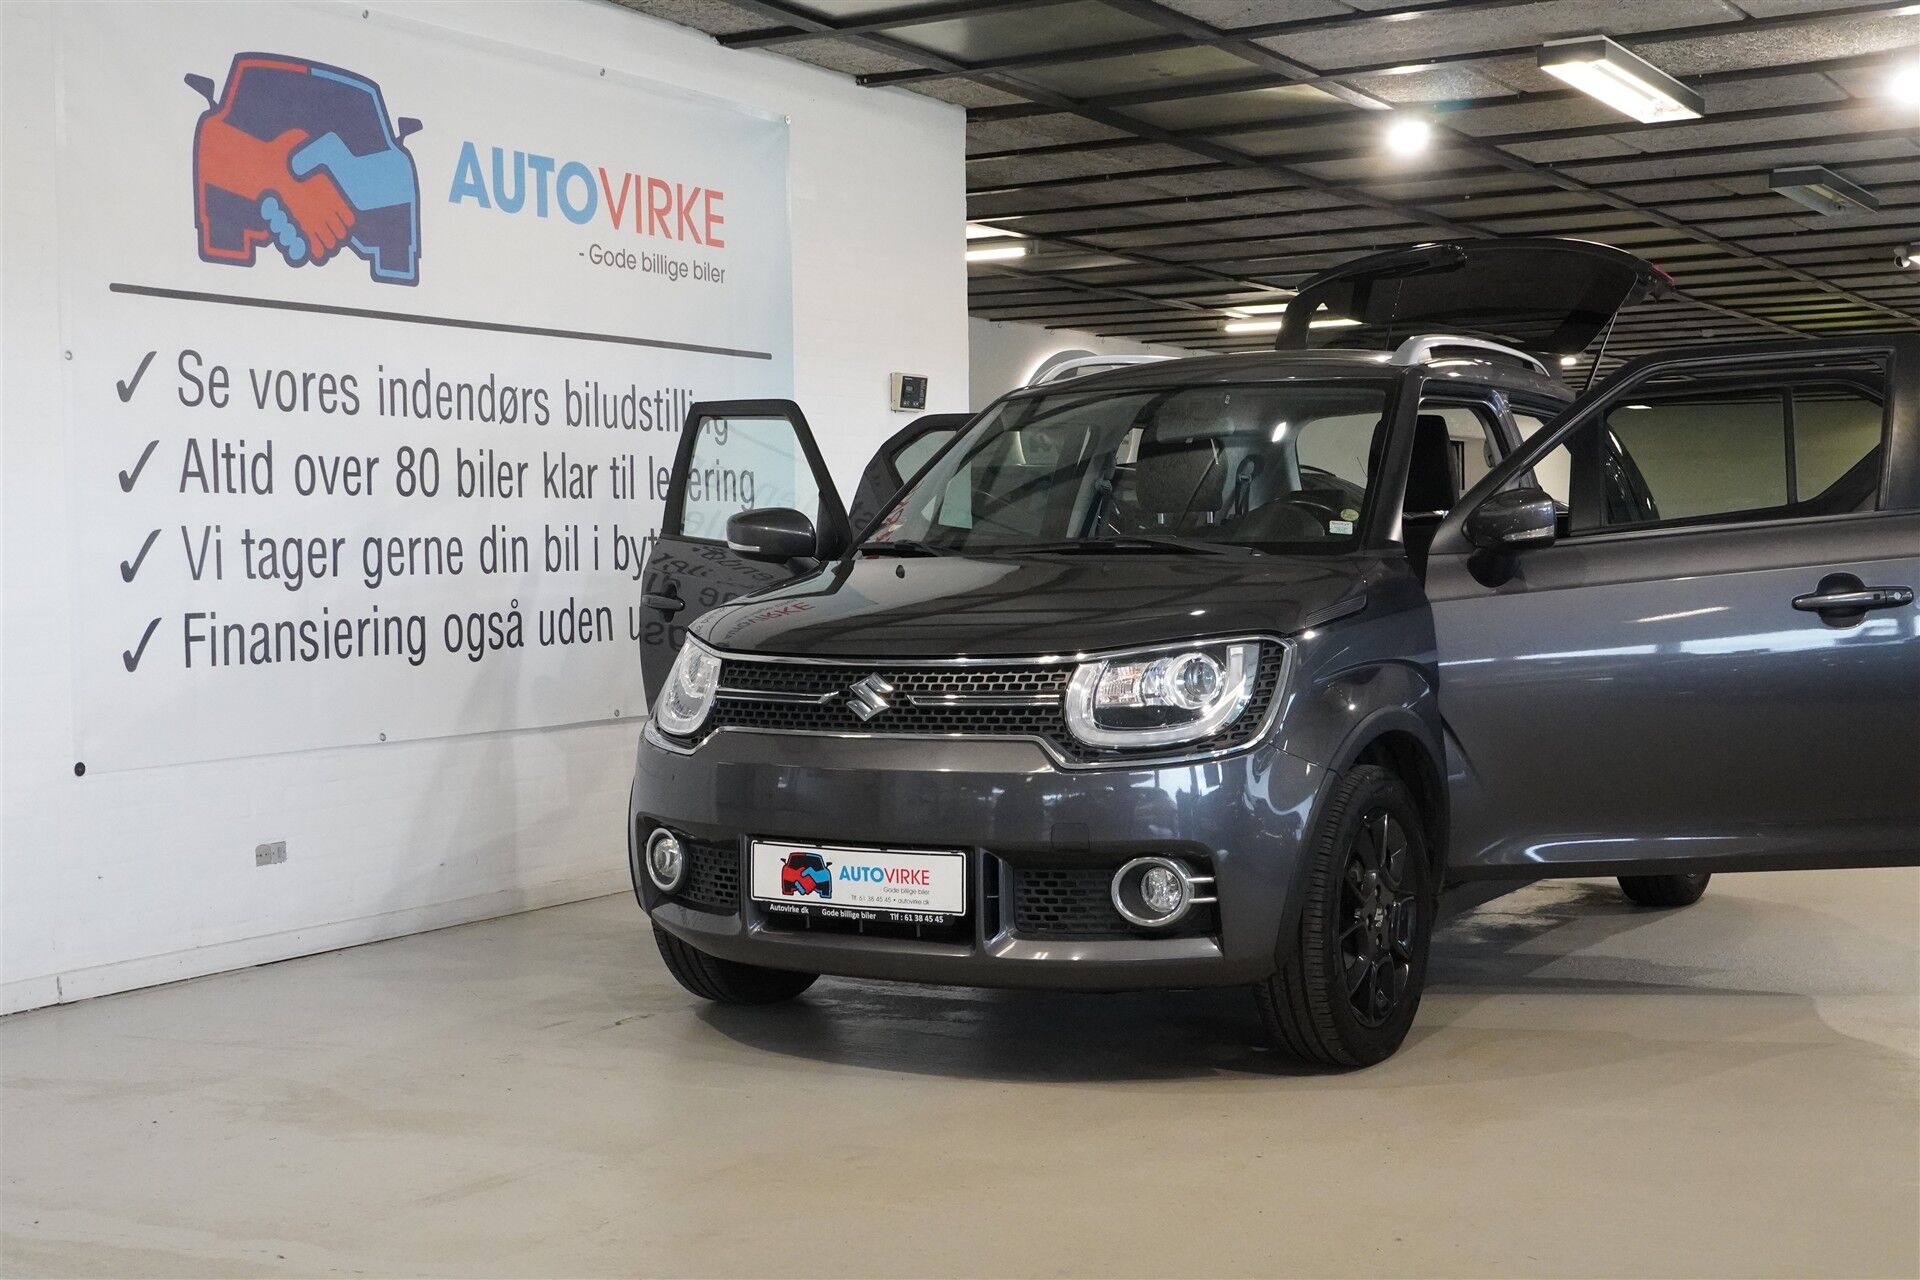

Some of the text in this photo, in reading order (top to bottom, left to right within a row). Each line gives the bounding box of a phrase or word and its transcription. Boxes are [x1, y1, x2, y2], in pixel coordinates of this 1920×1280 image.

[449, 141, 725, 249] AUTOVIRKE
[589, 243, 637, 270] Gode
[641, 251, 689, 282] billige
[693, 259, 726, 284] biler
[177, 350, 230, 409] Se
[248, 368, 361, 416] vores
[378, 365, 551, 427] indendørs
[178, 437, 756, 511] Altid over 80 biler klar til leering
[181, 524, 223, 581] Vi
[240, 529, 346, 592] tager
[362, 537, 464, 590] gerne
[479, 525, 529, 575] din
[544, 524, 579, 573] bil
[593, 524, 599, 571] i
[613, 524, 658, 581] byt
[184, 605, 427, 669] Finansiering
[443, 598, 525, 663] også
[539, 597, 614, 647] uden
[839, 865, 930, 886] AUTOVIRKE
[901, 887, 917, 895] billige
[769, 904, 799, 914] Autovirke
[822, 908, 839, 918] Gode
[840, 909, 860, 920] billige
[861, 911, 877, 920] biler
[904, 914, 913, 922] 61
[924, 915, 933, 923] 45
[934, 915, 944, 924] 45
